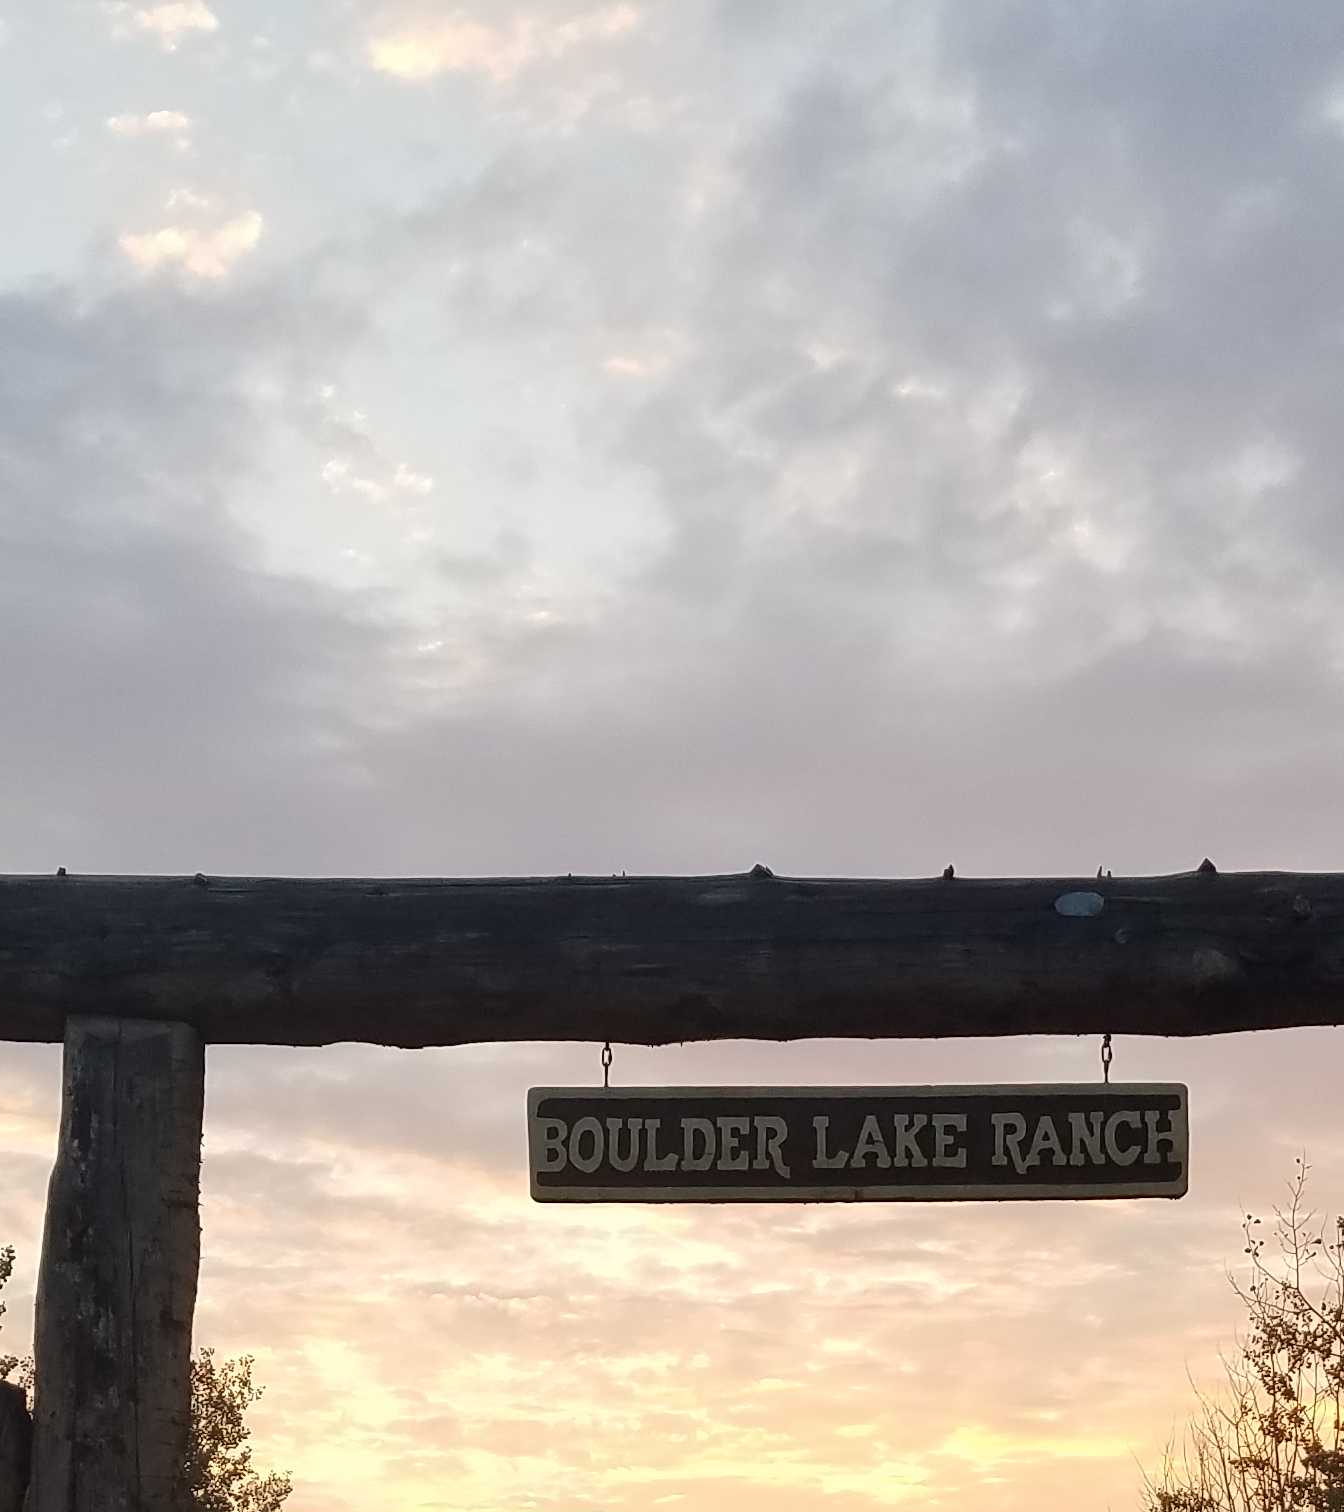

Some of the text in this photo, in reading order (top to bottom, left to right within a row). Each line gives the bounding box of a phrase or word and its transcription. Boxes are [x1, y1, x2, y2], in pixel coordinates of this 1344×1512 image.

[539, 1110, 1179, 1178] BOULDER LAKE RANCH
